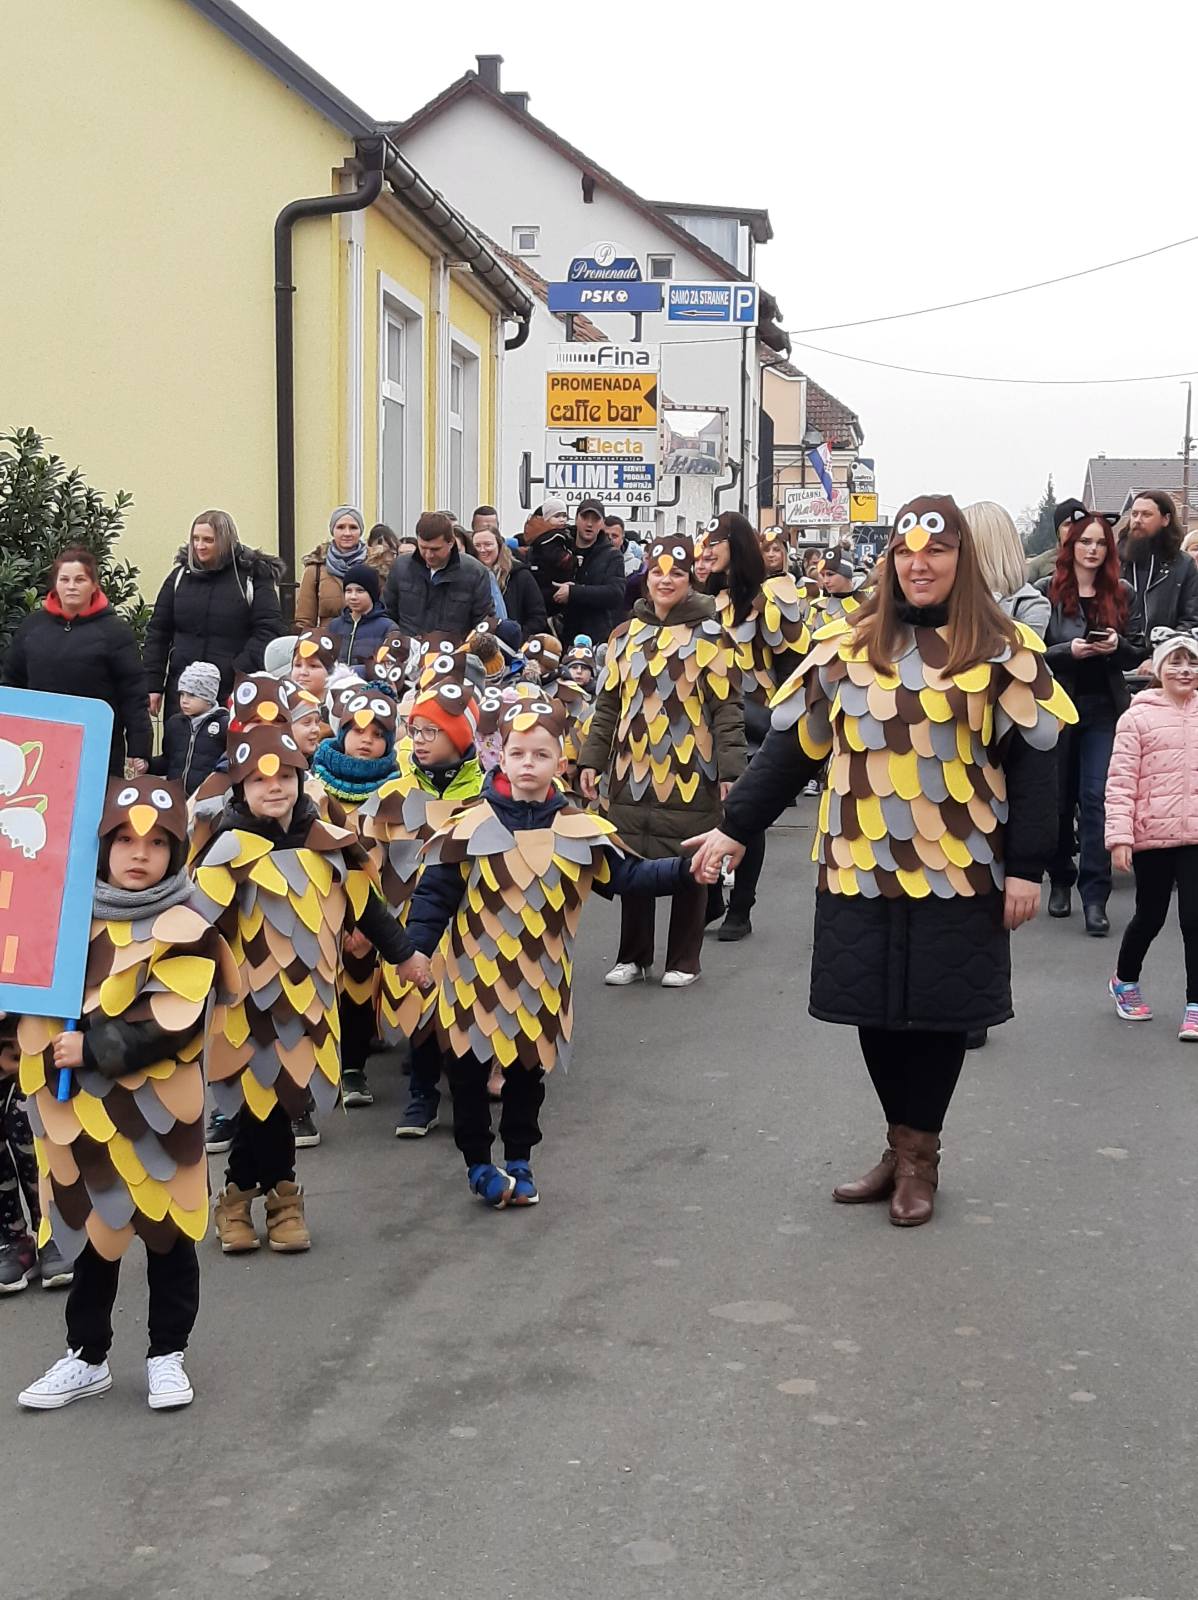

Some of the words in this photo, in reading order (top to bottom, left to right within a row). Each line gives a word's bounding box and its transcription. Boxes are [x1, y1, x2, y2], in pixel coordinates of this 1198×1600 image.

[571, 260, 639, 279] Promenada
[581, 289, 615, 303] PSK
[671, 290, 689, 305] SAMO
[690, 290, 699, 305] ZA
[700, 290, 730, 305] STRANKE
[736, 289, 753, 319] P
[598, 346, 650, 366] Fina
[551, 377, 642, 391] PROMENADA
[550, 399, 601, 422] caffe
[606, 399, 643, 422] bar
[549, 464, 619, 489] KLIME
[566, 491, 591, 502] 040
[597, 491, 621, 503] 544
[626, 491, 652, 503] 046
